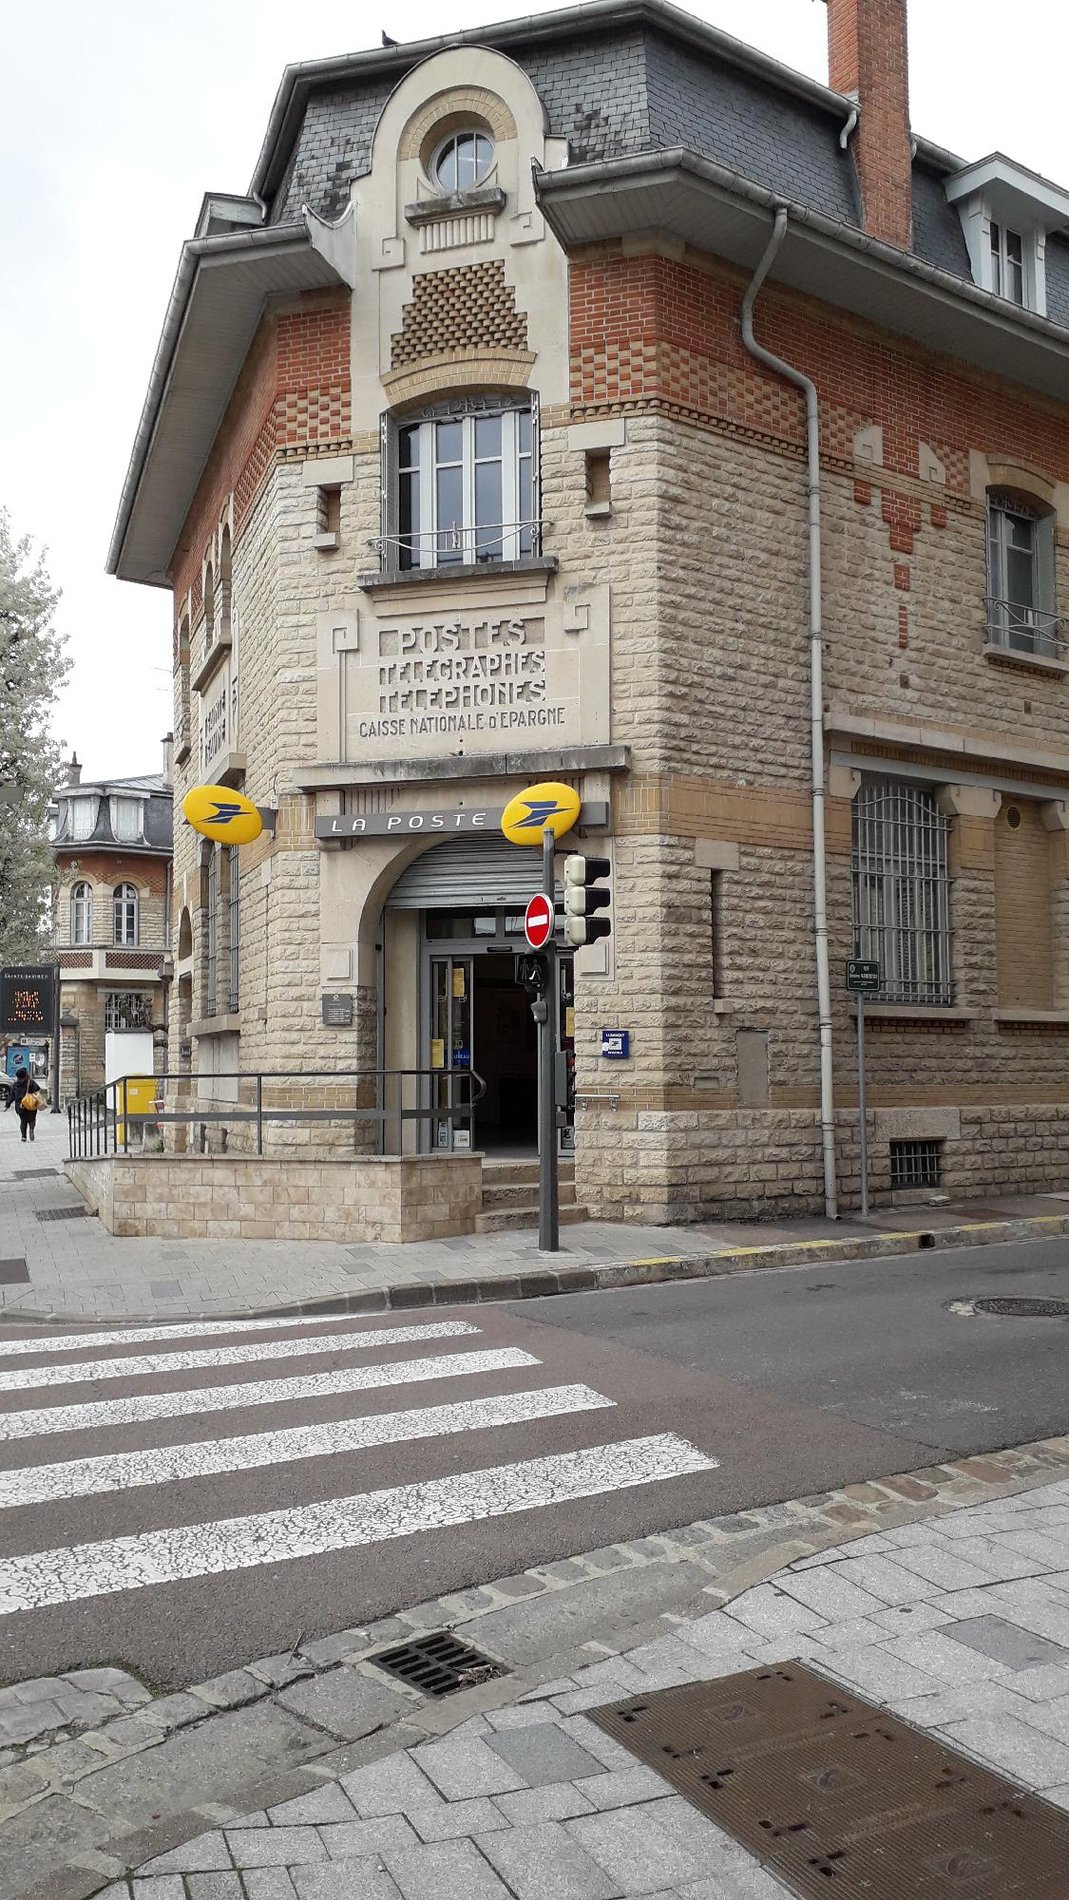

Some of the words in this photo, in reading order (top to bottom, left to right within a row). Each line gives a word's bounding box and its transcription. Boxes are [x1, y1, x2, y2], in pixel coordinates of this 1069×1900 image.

[400, 619, 526, 655] POSTES
[380, 651, 545, 685] TELEGRAPHES
[380, 680, 545, 714] TELEPHONES
[359, 717, 406, 738] CAISSE
[410, 712, 485, 734] NATIONALE
[331, 818, 366, 833] LA
[387, 812, 488, 830] POSTE
